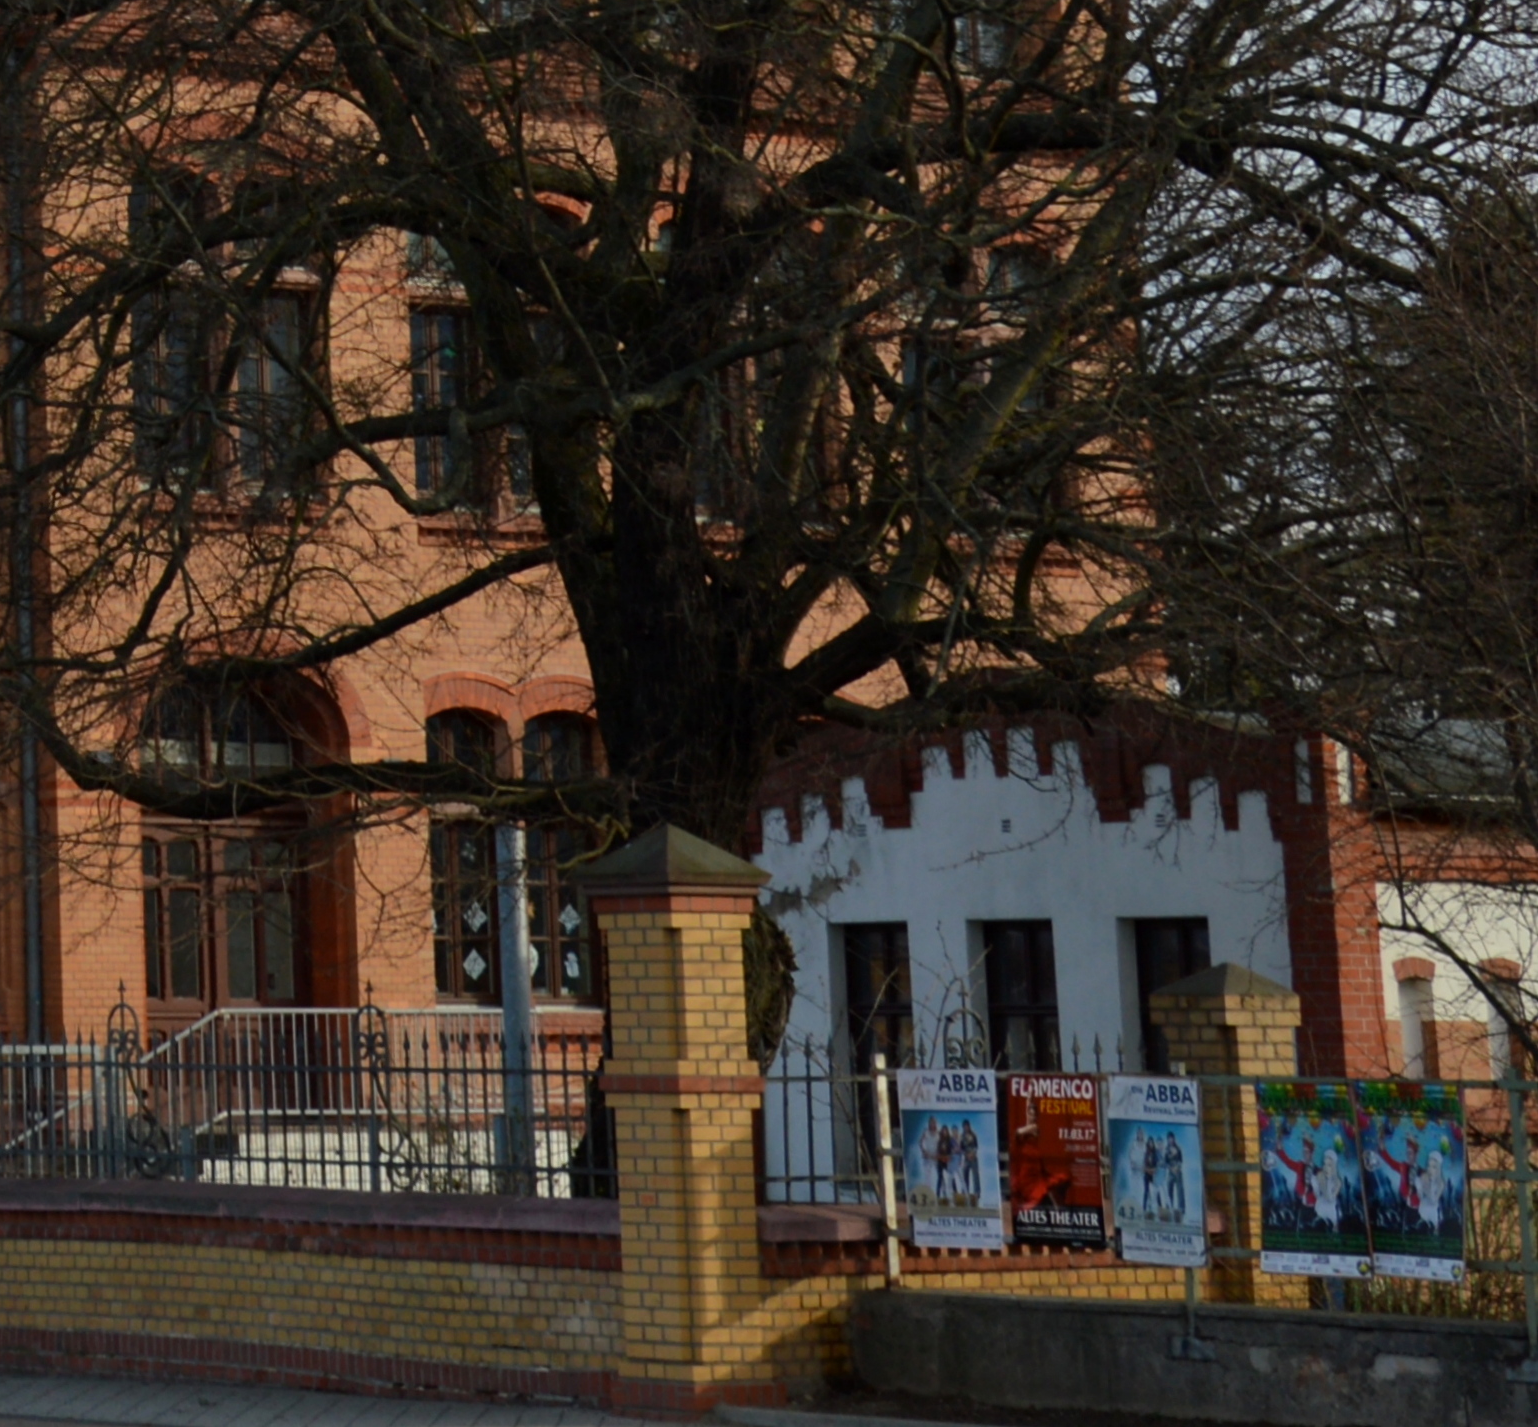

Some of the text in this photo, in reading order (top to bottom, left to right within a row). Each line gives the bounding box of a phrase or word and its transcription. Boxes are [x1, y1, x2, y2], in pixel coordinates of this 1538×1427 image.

[939, 1074, 989, 1092] ABBA
[1011, 1077, 1093, 1100] FLAMENCO
[1146, 1083, 1194, 1105] ABBA
[1040, 1099, 1094, 1115] FESTIVAL
[1017, 1210, 1100, 1227] ALTES THEATER
